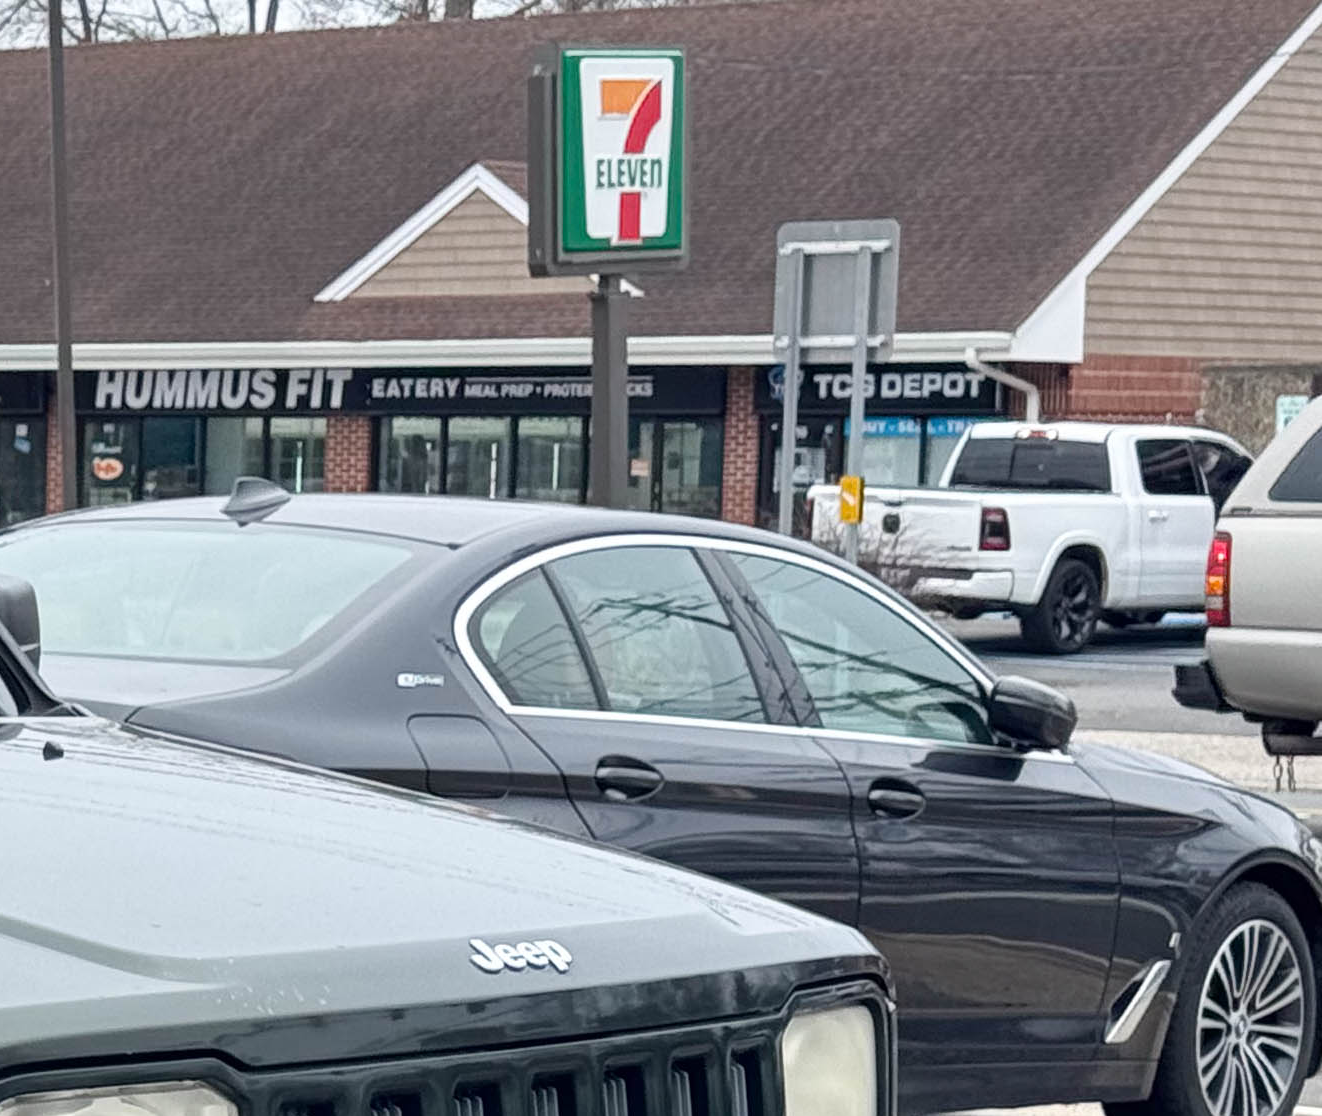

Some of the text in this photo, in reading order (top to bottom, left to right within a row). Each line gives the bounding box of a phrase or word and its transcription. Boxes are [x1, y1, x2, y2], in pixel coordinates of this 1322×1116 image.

[599, 79, 663, 241] 7
[94, 368, 353, 410] HUMMUS FIT
[371, 377, 460, 399] EATERY
[464, 384, 499, 398] MEAL
[500, 383, 534, 398] PREP
[880, 372, 985, 399] DEPOT
[468, 938, 573, 974] Jeep
